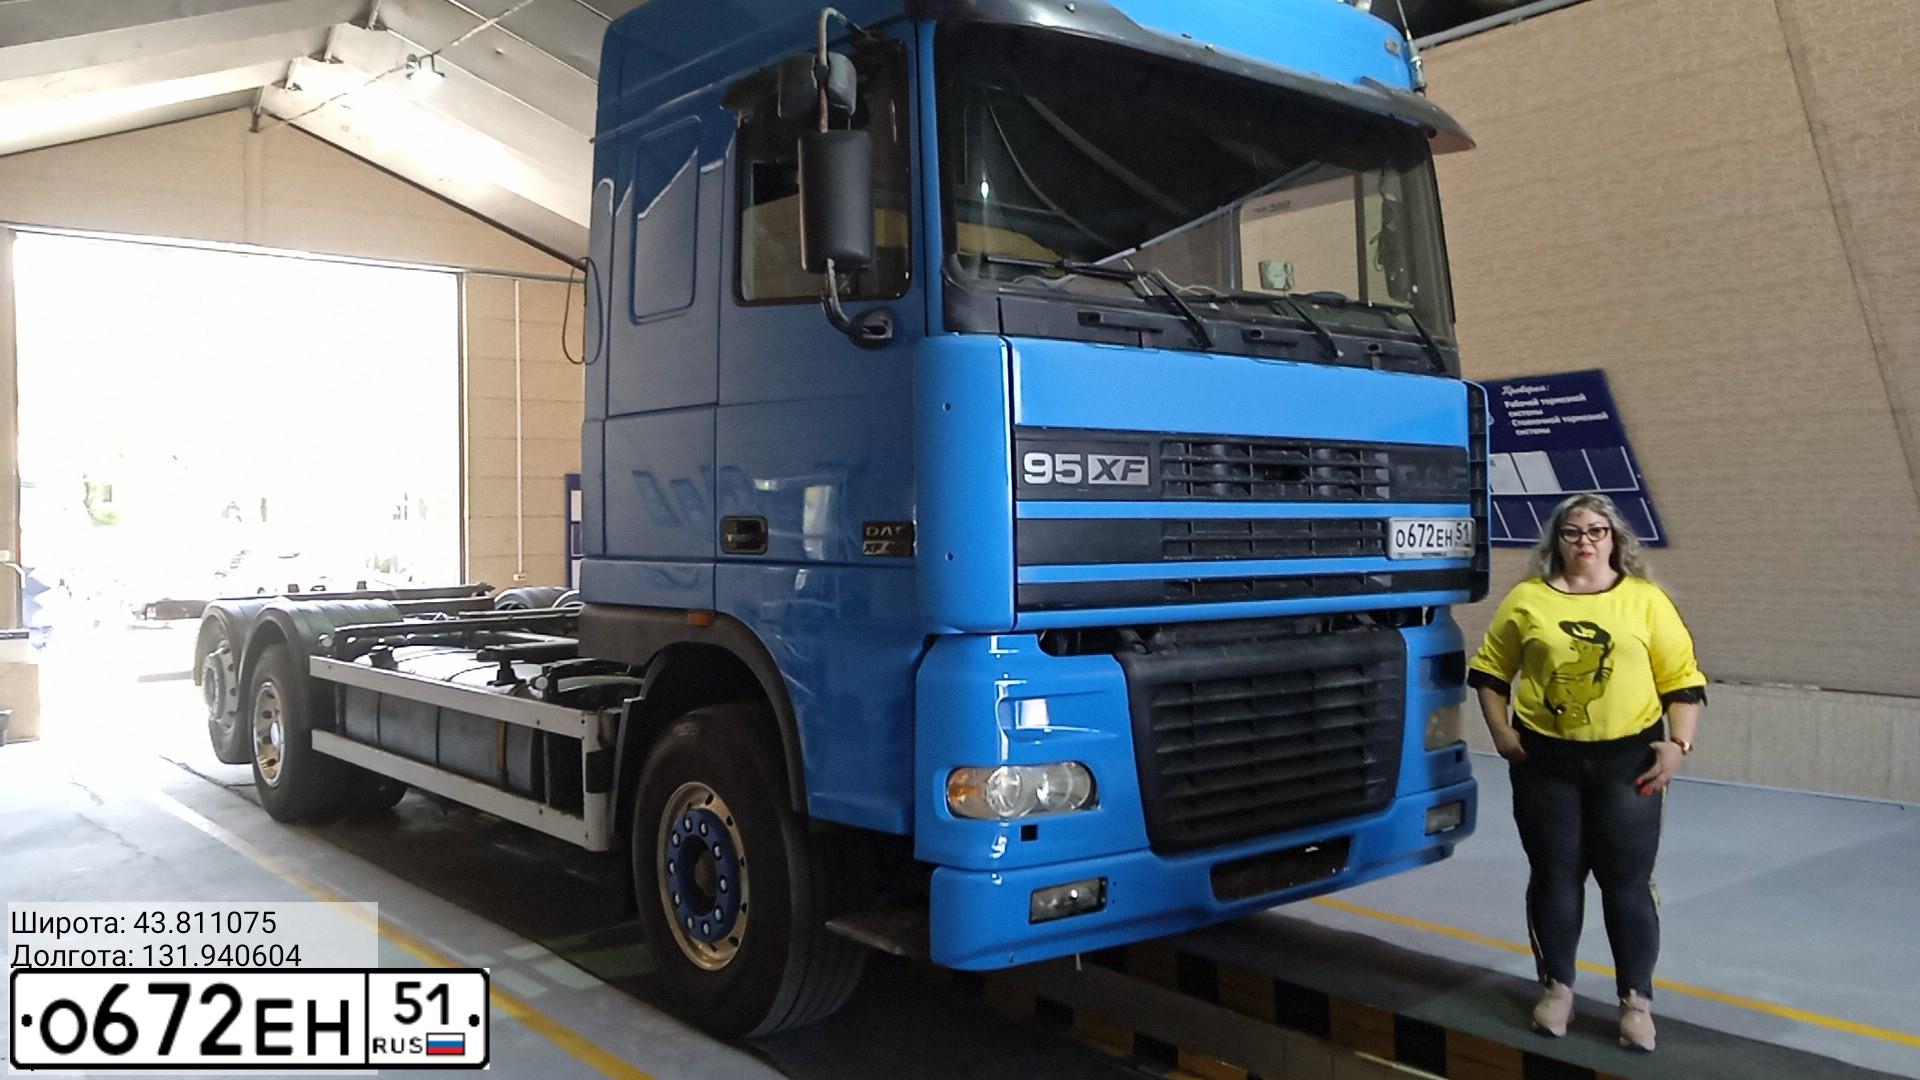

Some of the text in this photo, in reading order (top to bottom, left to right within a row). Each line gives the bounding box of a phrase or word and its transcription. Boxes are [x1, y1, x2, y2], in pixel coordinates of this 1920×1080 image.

[1023, 452, 1146, 485] 95 XF
[1395, 522, 1469, 548] О672ЕН 51
